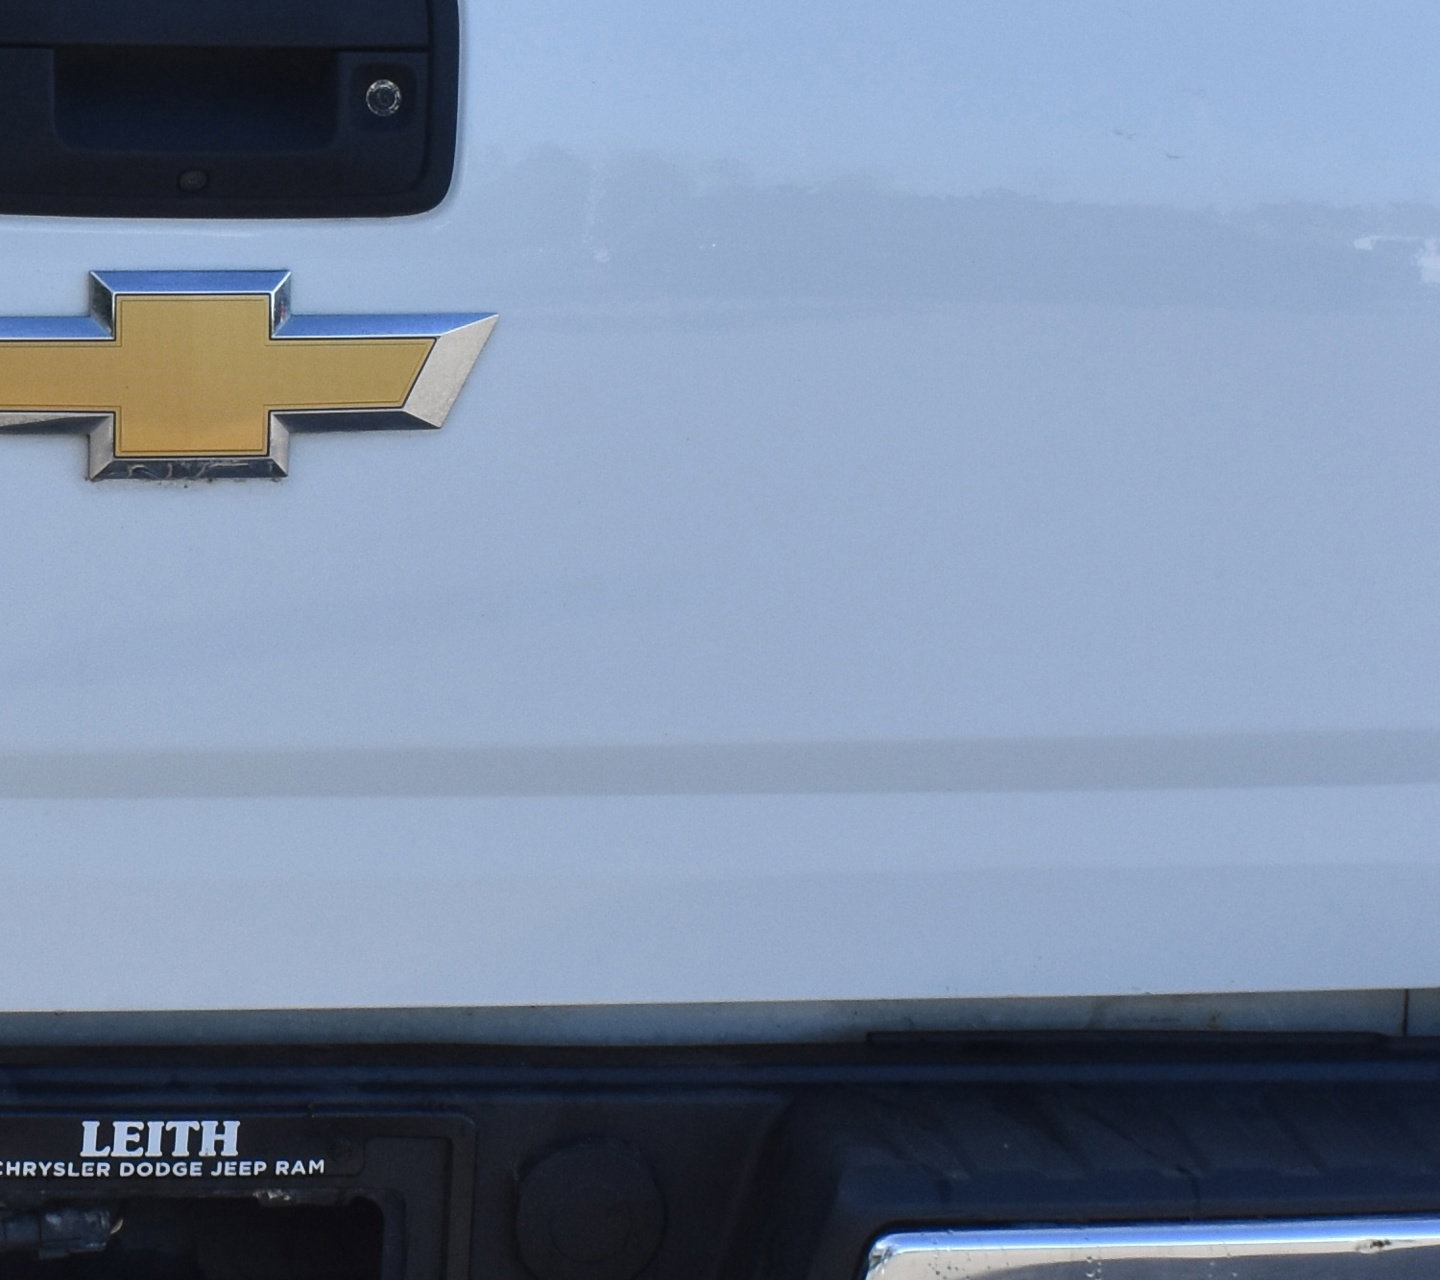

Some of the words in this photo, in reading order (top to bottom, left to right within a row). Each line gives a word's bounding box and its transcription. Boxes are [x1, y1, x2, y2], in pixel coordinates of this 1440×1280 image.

[79, 1120, 241, 1157] LEITH
[119, 1161, 203, 1178] DODGE
[210, 1160, 268, 1177] JEEP
[275, 1158, 326, 1176] RAM
